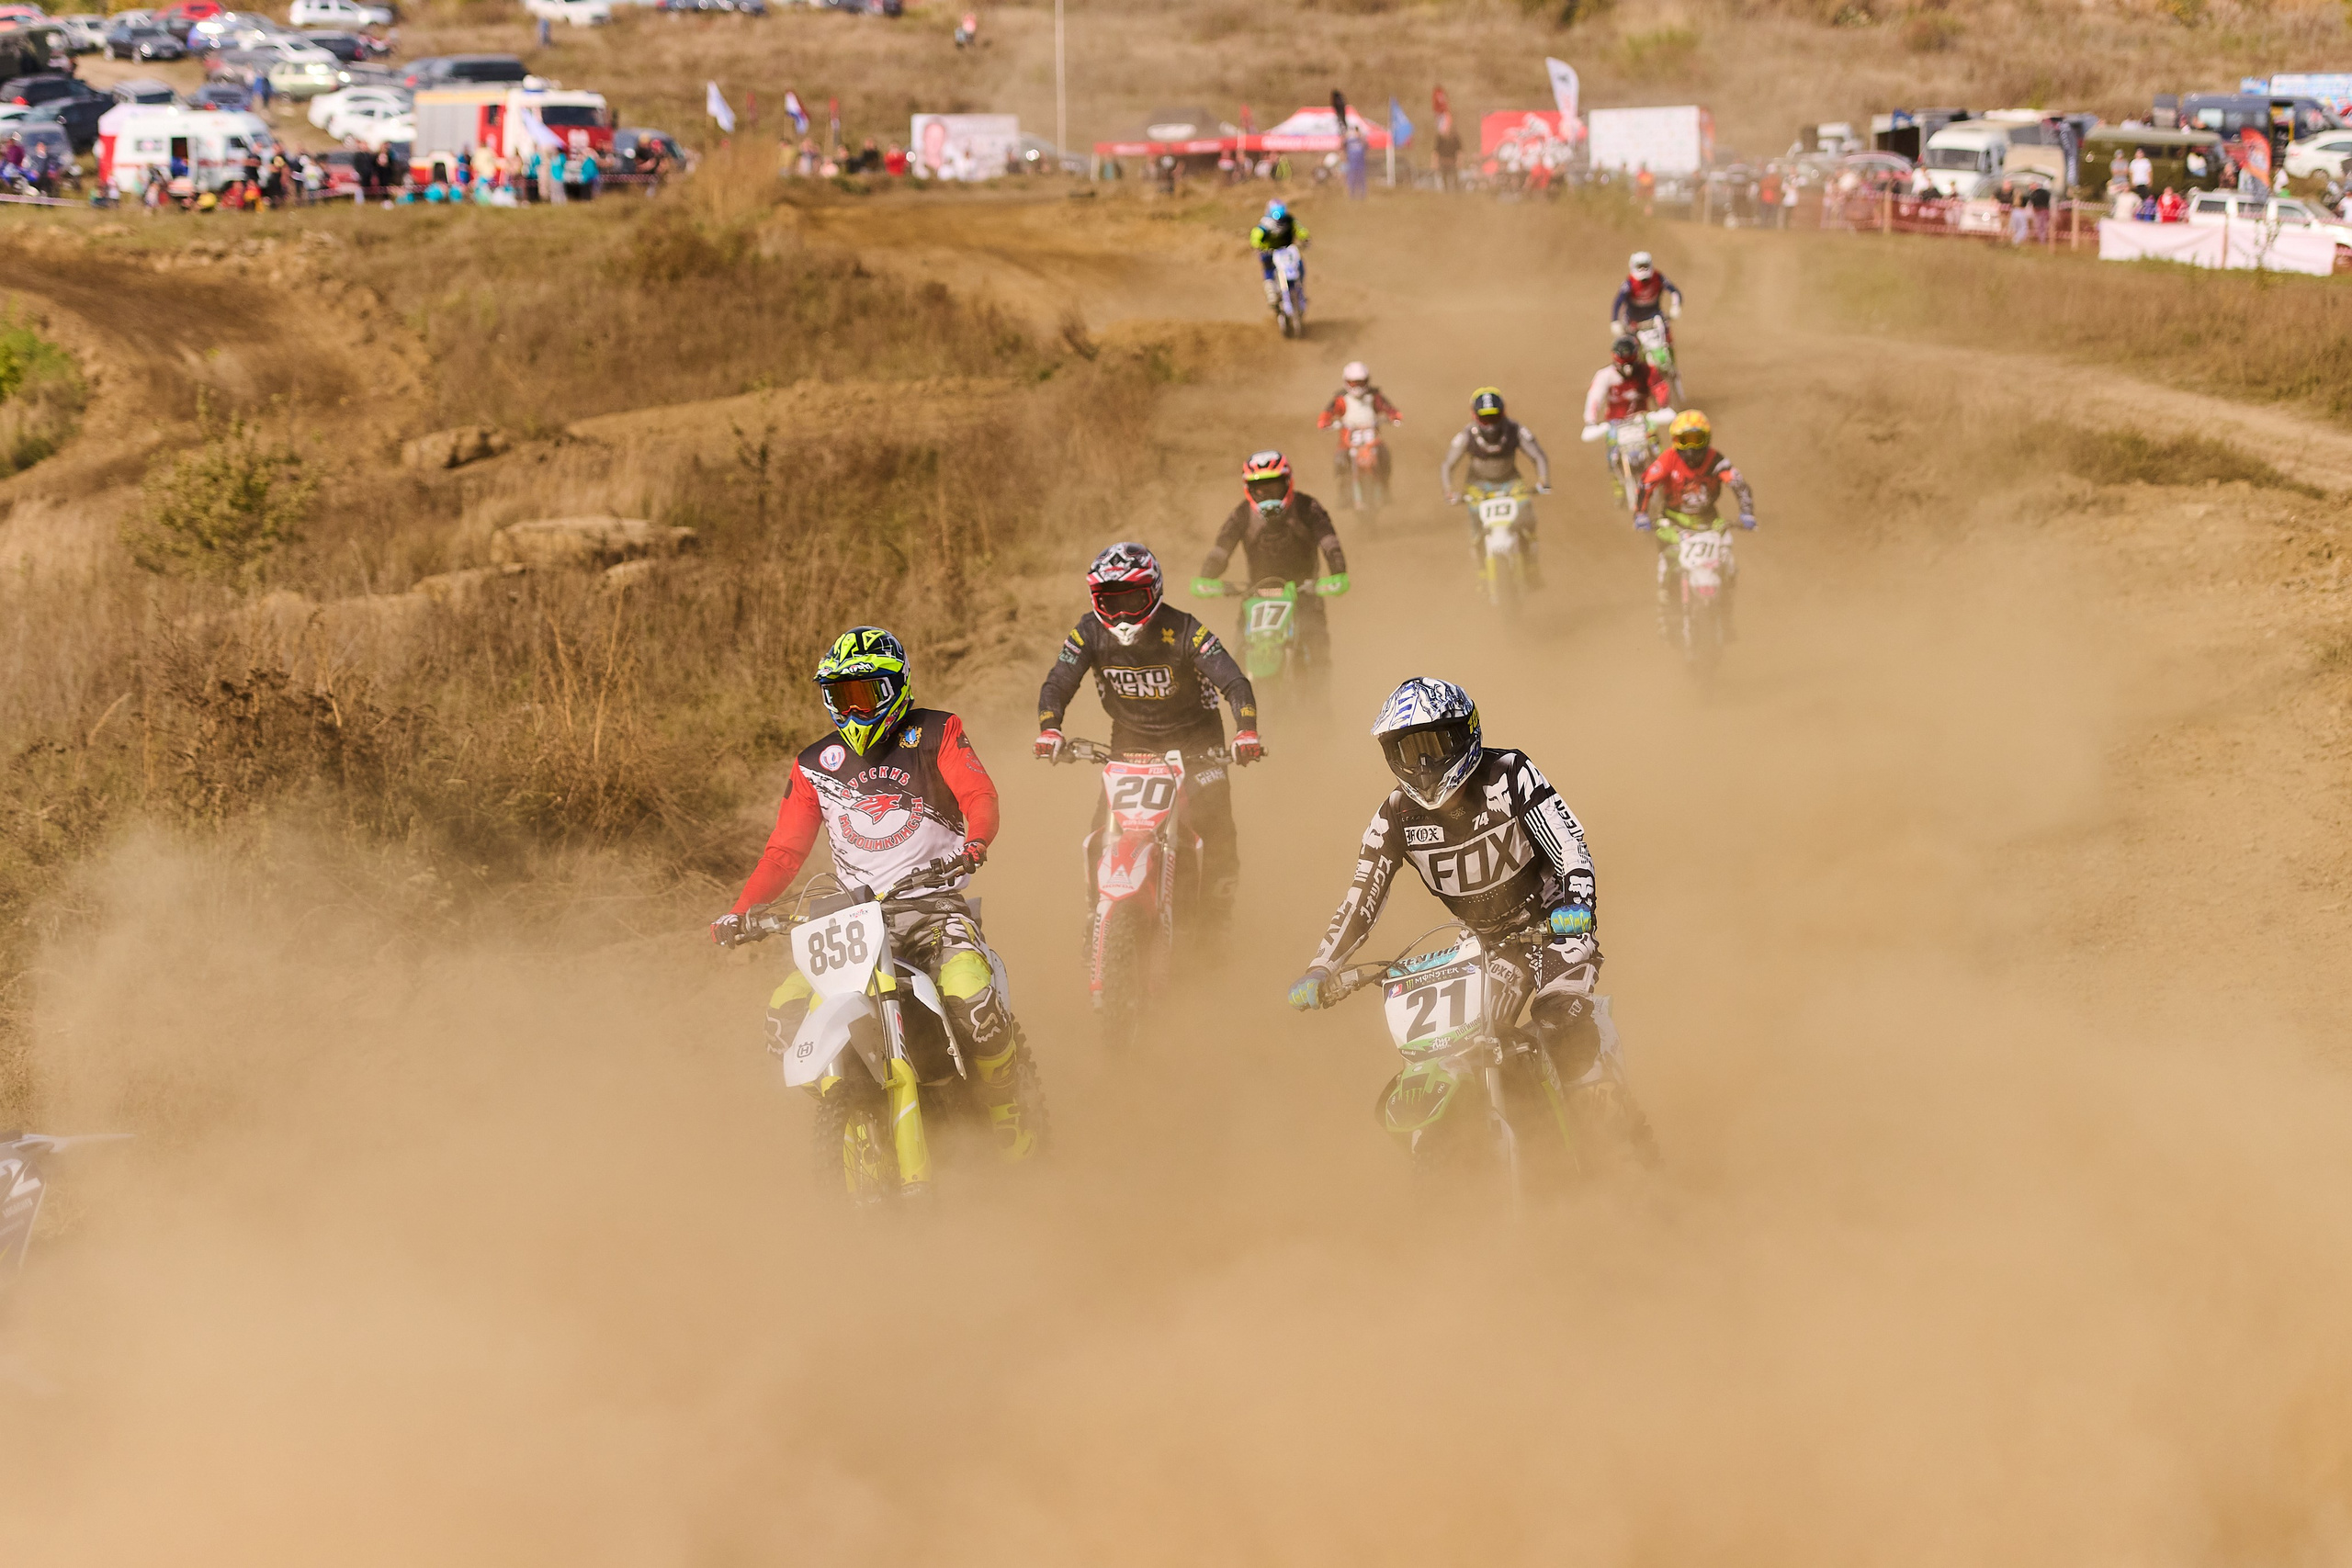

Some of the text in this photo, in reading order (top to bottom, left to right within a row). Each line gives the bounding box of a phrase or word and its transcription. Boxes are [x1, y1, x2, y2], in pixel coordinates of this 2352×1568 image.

[1685, 541, 1715, 558] 731
[1251, 602, 1290, 631] 17
[1105, 669, 1168, 684] MOTO
[1112, 775, 1175, 810] 20
[838, 796, 923, 852] МОТОЦИКЛИСТЫ
[1406, 828, 1440, 843] FOX
[1472, 811, 1489, 831] 74
[1429, 822, 1521, 893] FOX
[808, 919, 869, 976] 858
[1415, 967, 1459, 984] MONSTER
[1406, 979, 1467, 1043] 21
